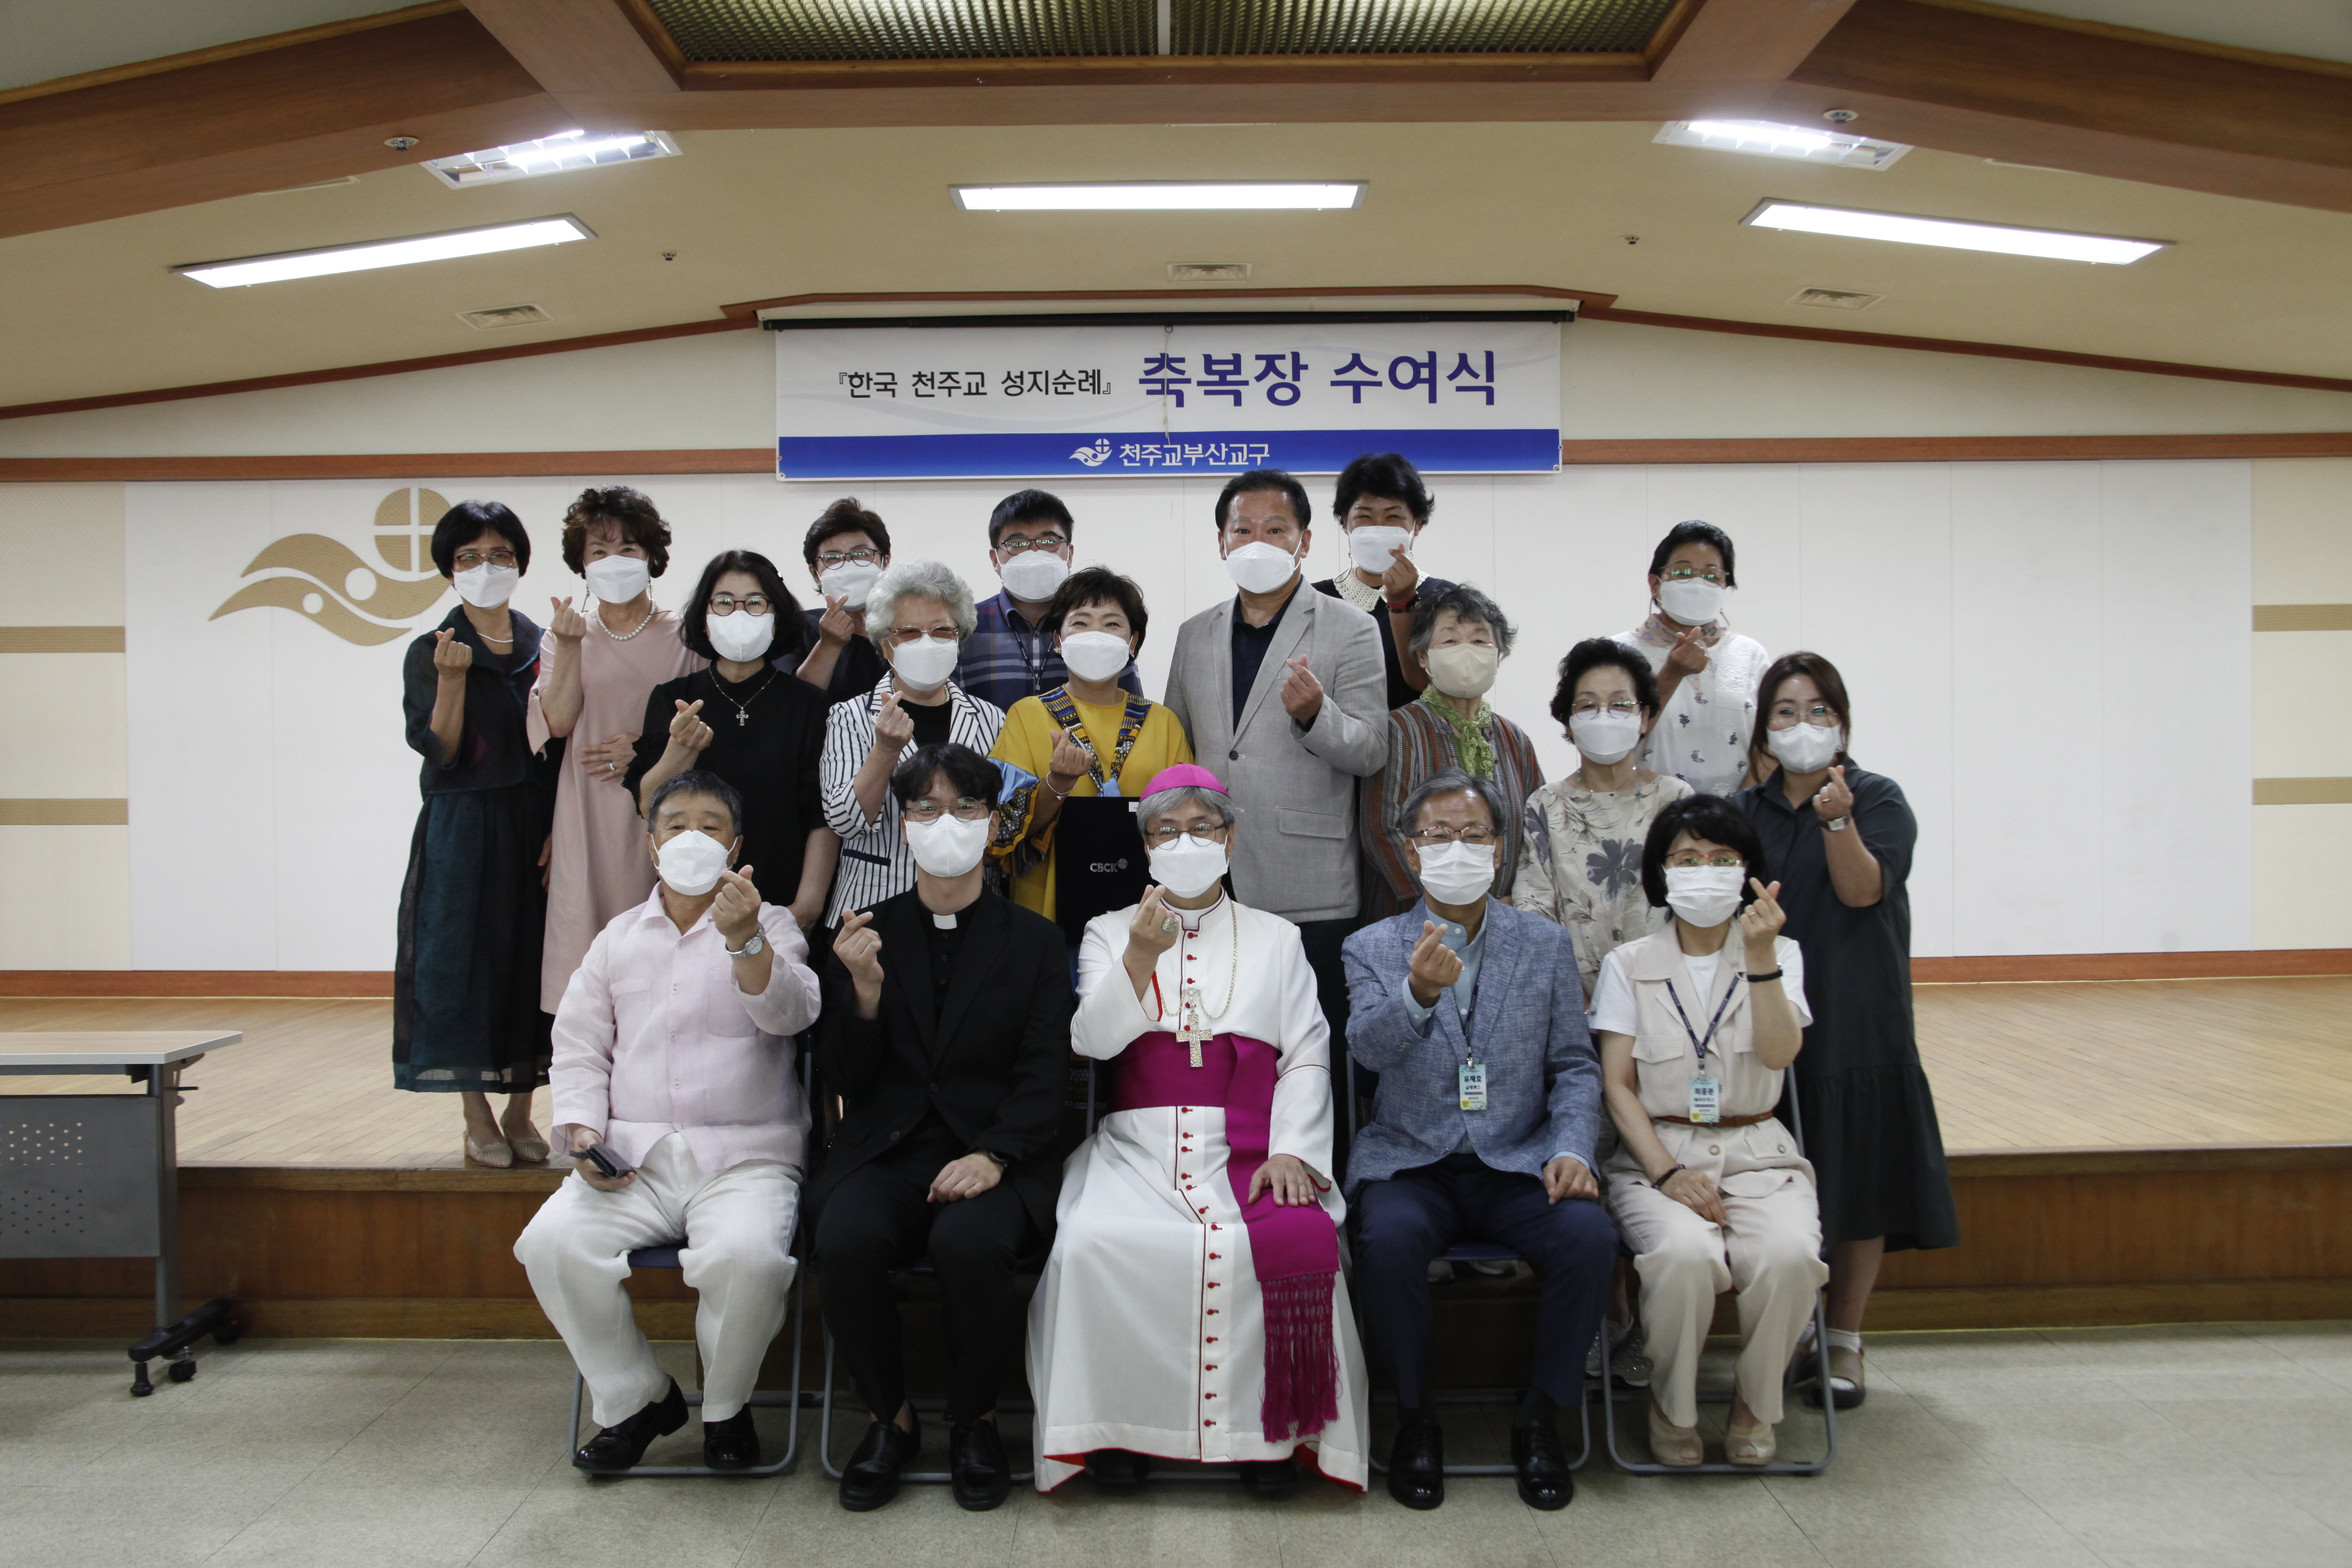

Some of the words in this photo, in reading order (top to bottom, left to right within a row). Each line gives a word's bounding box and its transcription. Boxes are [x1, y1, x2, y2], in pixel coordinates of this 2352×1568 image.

[839, 371, 898, 398] 『한국
[911, 371, 988, 398] 천주교
[1001, 369, 1111, 397] 성지순례』
[1138, 351, 1309, 408] 축복장
[1330, 350, 1495, 406] 수여식
[1119, 443, 1270, 467] 천주교부산교구
[1090, 863, 1117, 872] CBCK
